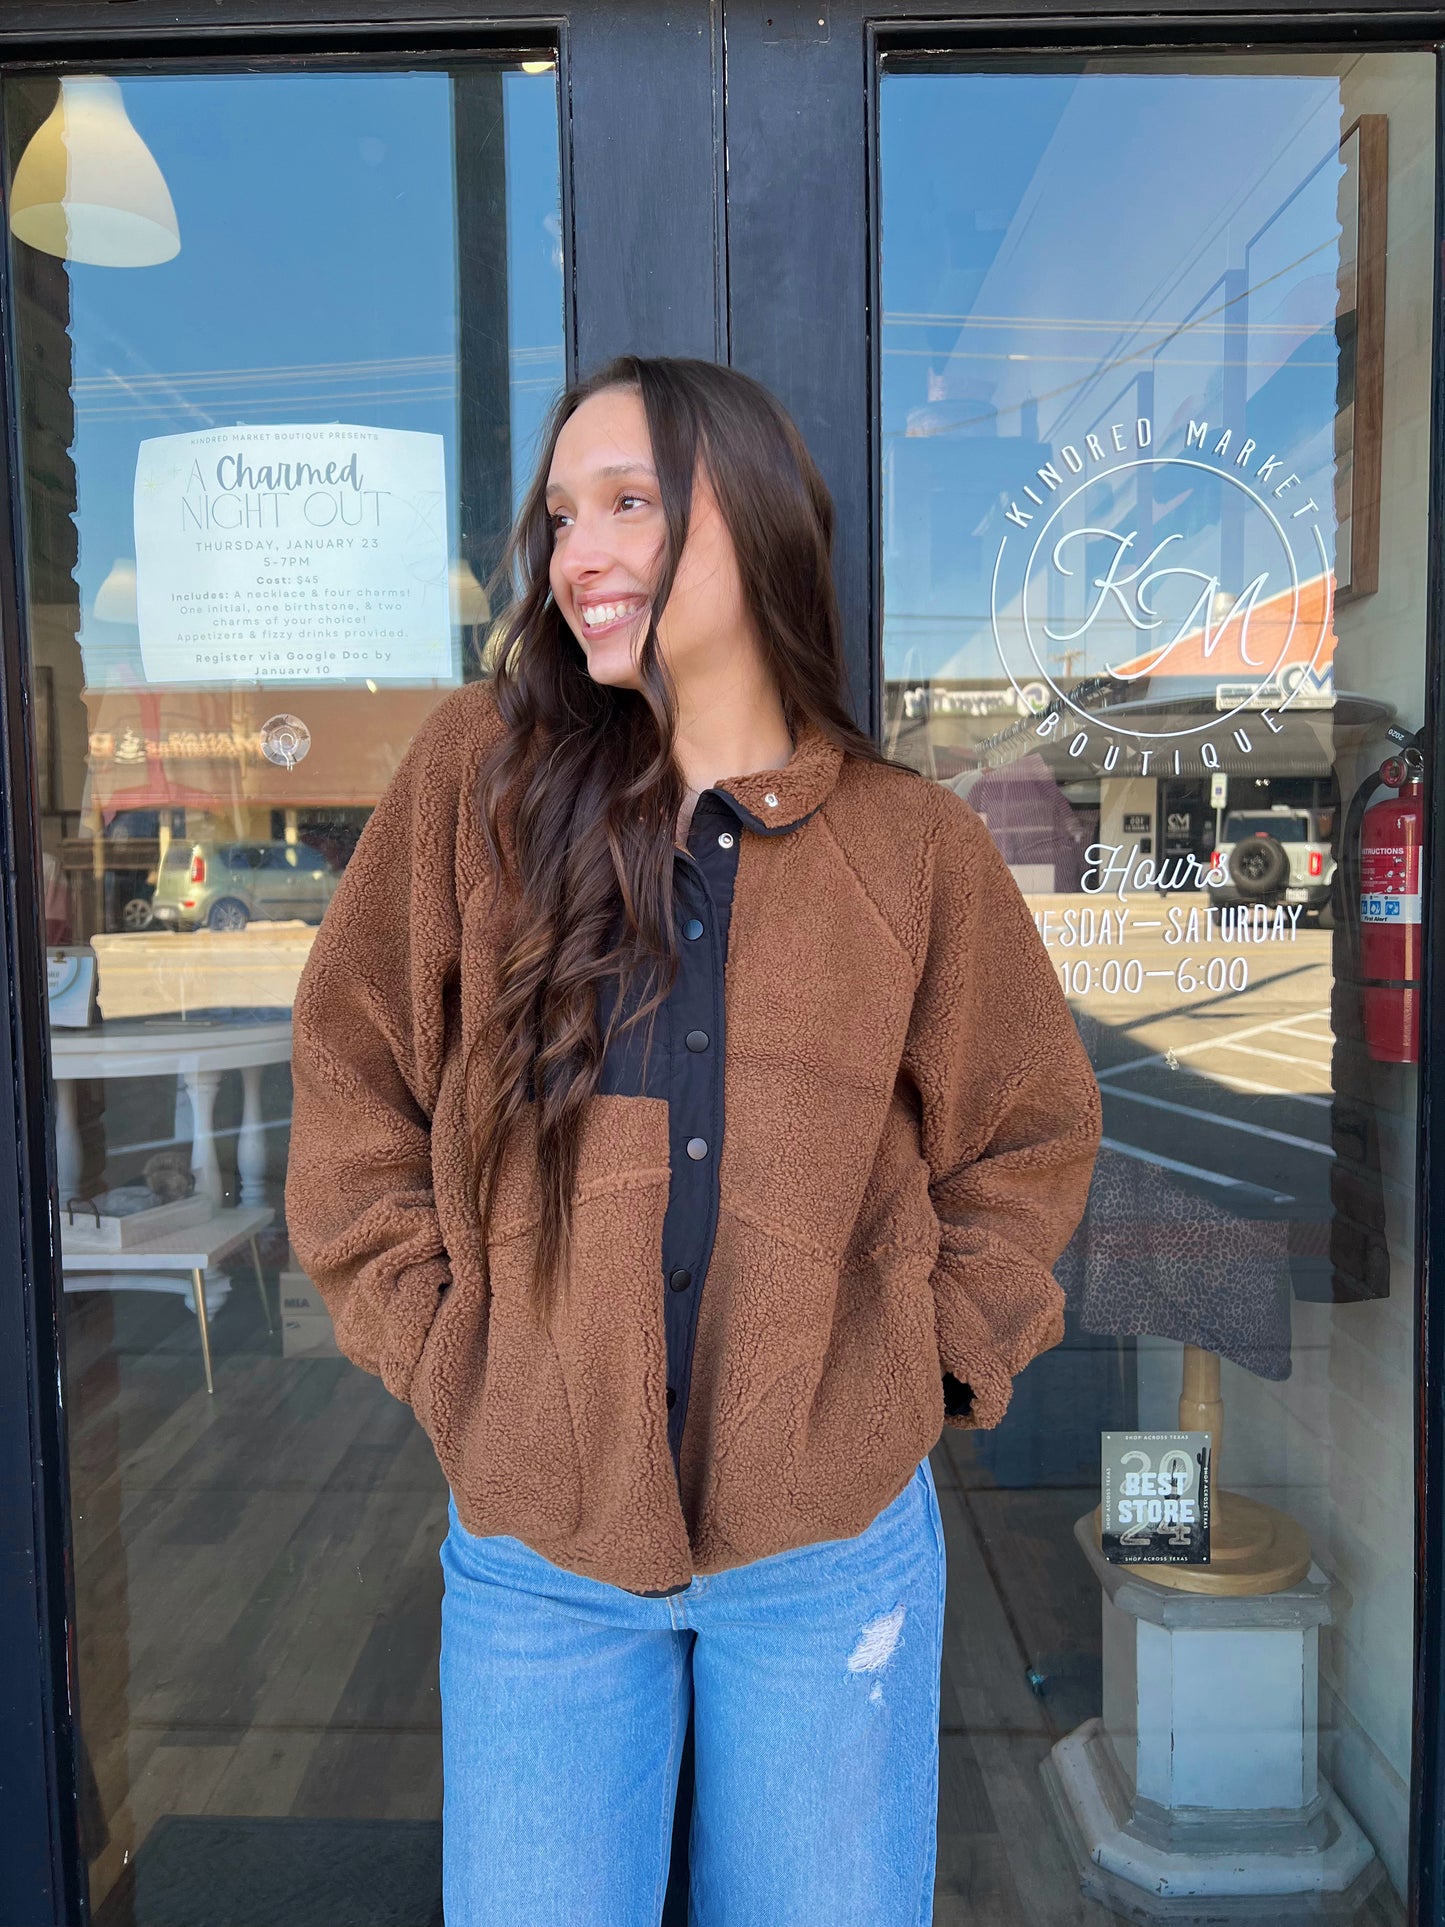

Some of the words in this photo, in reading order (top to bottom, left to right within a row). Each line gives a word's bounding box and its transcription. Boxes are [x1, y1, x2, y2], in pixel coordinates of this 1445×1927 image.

[190, 435, 228, 445] KINDRED
[232, 433, 270, 441] MARKET
[275, 432, 325, 440] BOUTIQUE
[328, 431, 379, 441] PRESENTS
[186, 458, 206, 493] A
[216, 452, 364, 492] Charmed
[1005, 417, 1151, 528] KINDRED
[1186, 419, 1319, 518] MARKET
[182, 492, 290, 531] NIGHT
[304, 490, 392, 527] OUT
[195, 540, 280, 552] THURSDAY,
[286, 538, 354, 550] JANUARY
[361, 538, 379, 549] 23
[263, 556, 310, 567] 5-7PM
[256, 576, 292, 585] Cost:
[296, 575, 319, 585] $45
[171, 591, 230, 602] Includes:
[233, 591, 241, 599] A
[247, 589, 306, 598] necklace
[311, 589, 319, 598] &
[324, 588, 351, 597] four
[356, 588, 411, 598] charms!
[180, 606, 203, 615] One
[207, 603, 251, 613] initial,
[256, 604, 279, 612] one
[284, 602, 360, 612] birthstone,
[365, 601, 373, 610] &
[378, 602, 402, 611] two
[212, 618, 260, 626] charms
[265, 616, 278, 625] of
[284, 617, 312, 627] your
[318, 615, 366, 625] choice!
[176, 632, 244, 643] Appetizers
[249, 630, 257, 639] &
[262, 630, 293, 640] fizzy
[298, 629, 339, 638] drinks
[344, 629, 409, 639] provided.
[195, 652, 254, 664] Register
[259, 651, 280, 661] via
[286, 650, 337, 662] Google
[342, 650, 369, 660] Doc
[375, 650, 392, 661] by
[254, 666, 311, 675] January
[316, 665, 331, 674] 10
[1036, 707, 1284, 776] BOUTIQUE
[1080, 843, 1231, 902] Hours
[1125, 1472, 1188, 1496] BEST
[1118, 1499, 1195, 1523] STORE
